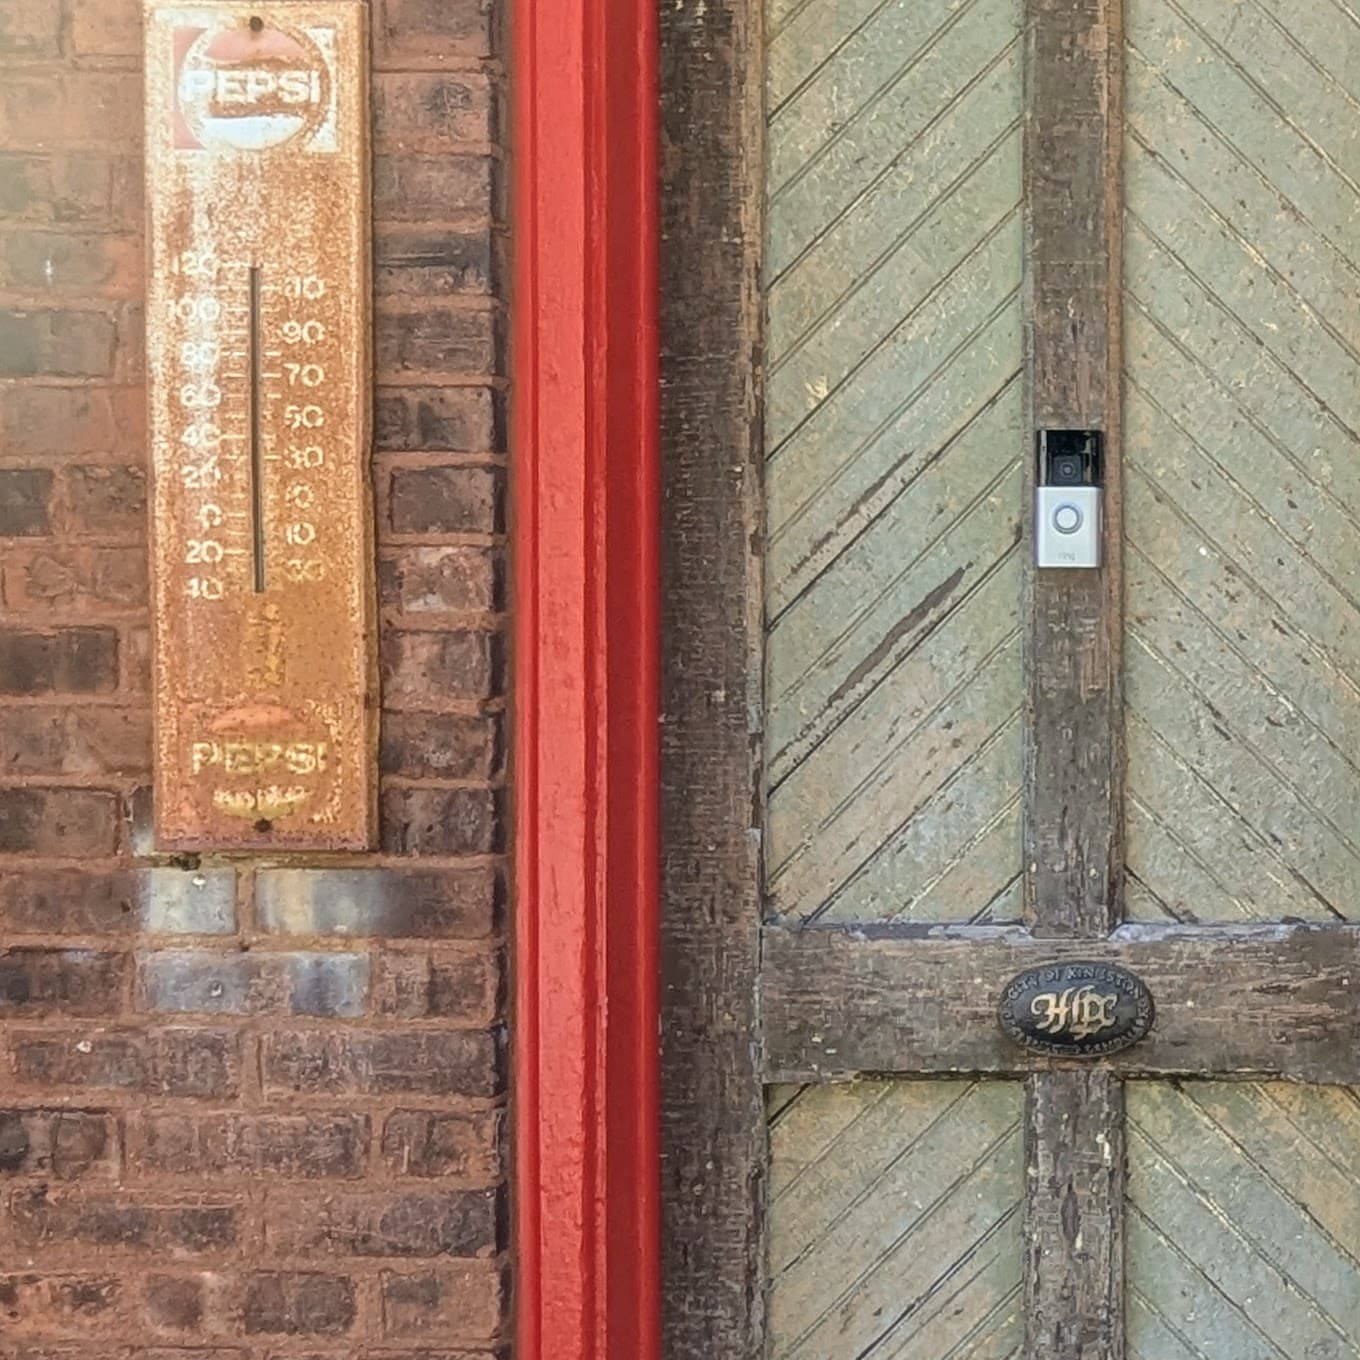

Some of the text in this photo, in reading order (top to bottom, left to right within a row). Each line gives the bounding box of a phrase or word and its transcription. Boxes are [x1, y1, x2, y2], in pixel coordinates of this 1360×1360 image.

[177, 69, 321, 104] PEPSI
[278, 320, 325, 345] 90
[283, 362, 325, 387] 70
[180, 383, 222, 408] 60
[284, 405, 325, 429] 50
[284, 444, 324, 469] 30
[181, 464, 222, 489] 20
[286, 522, 316, 545] 10
[185, 540, 224, 564] 20
[192, 742, 327, 775] PEPSI
